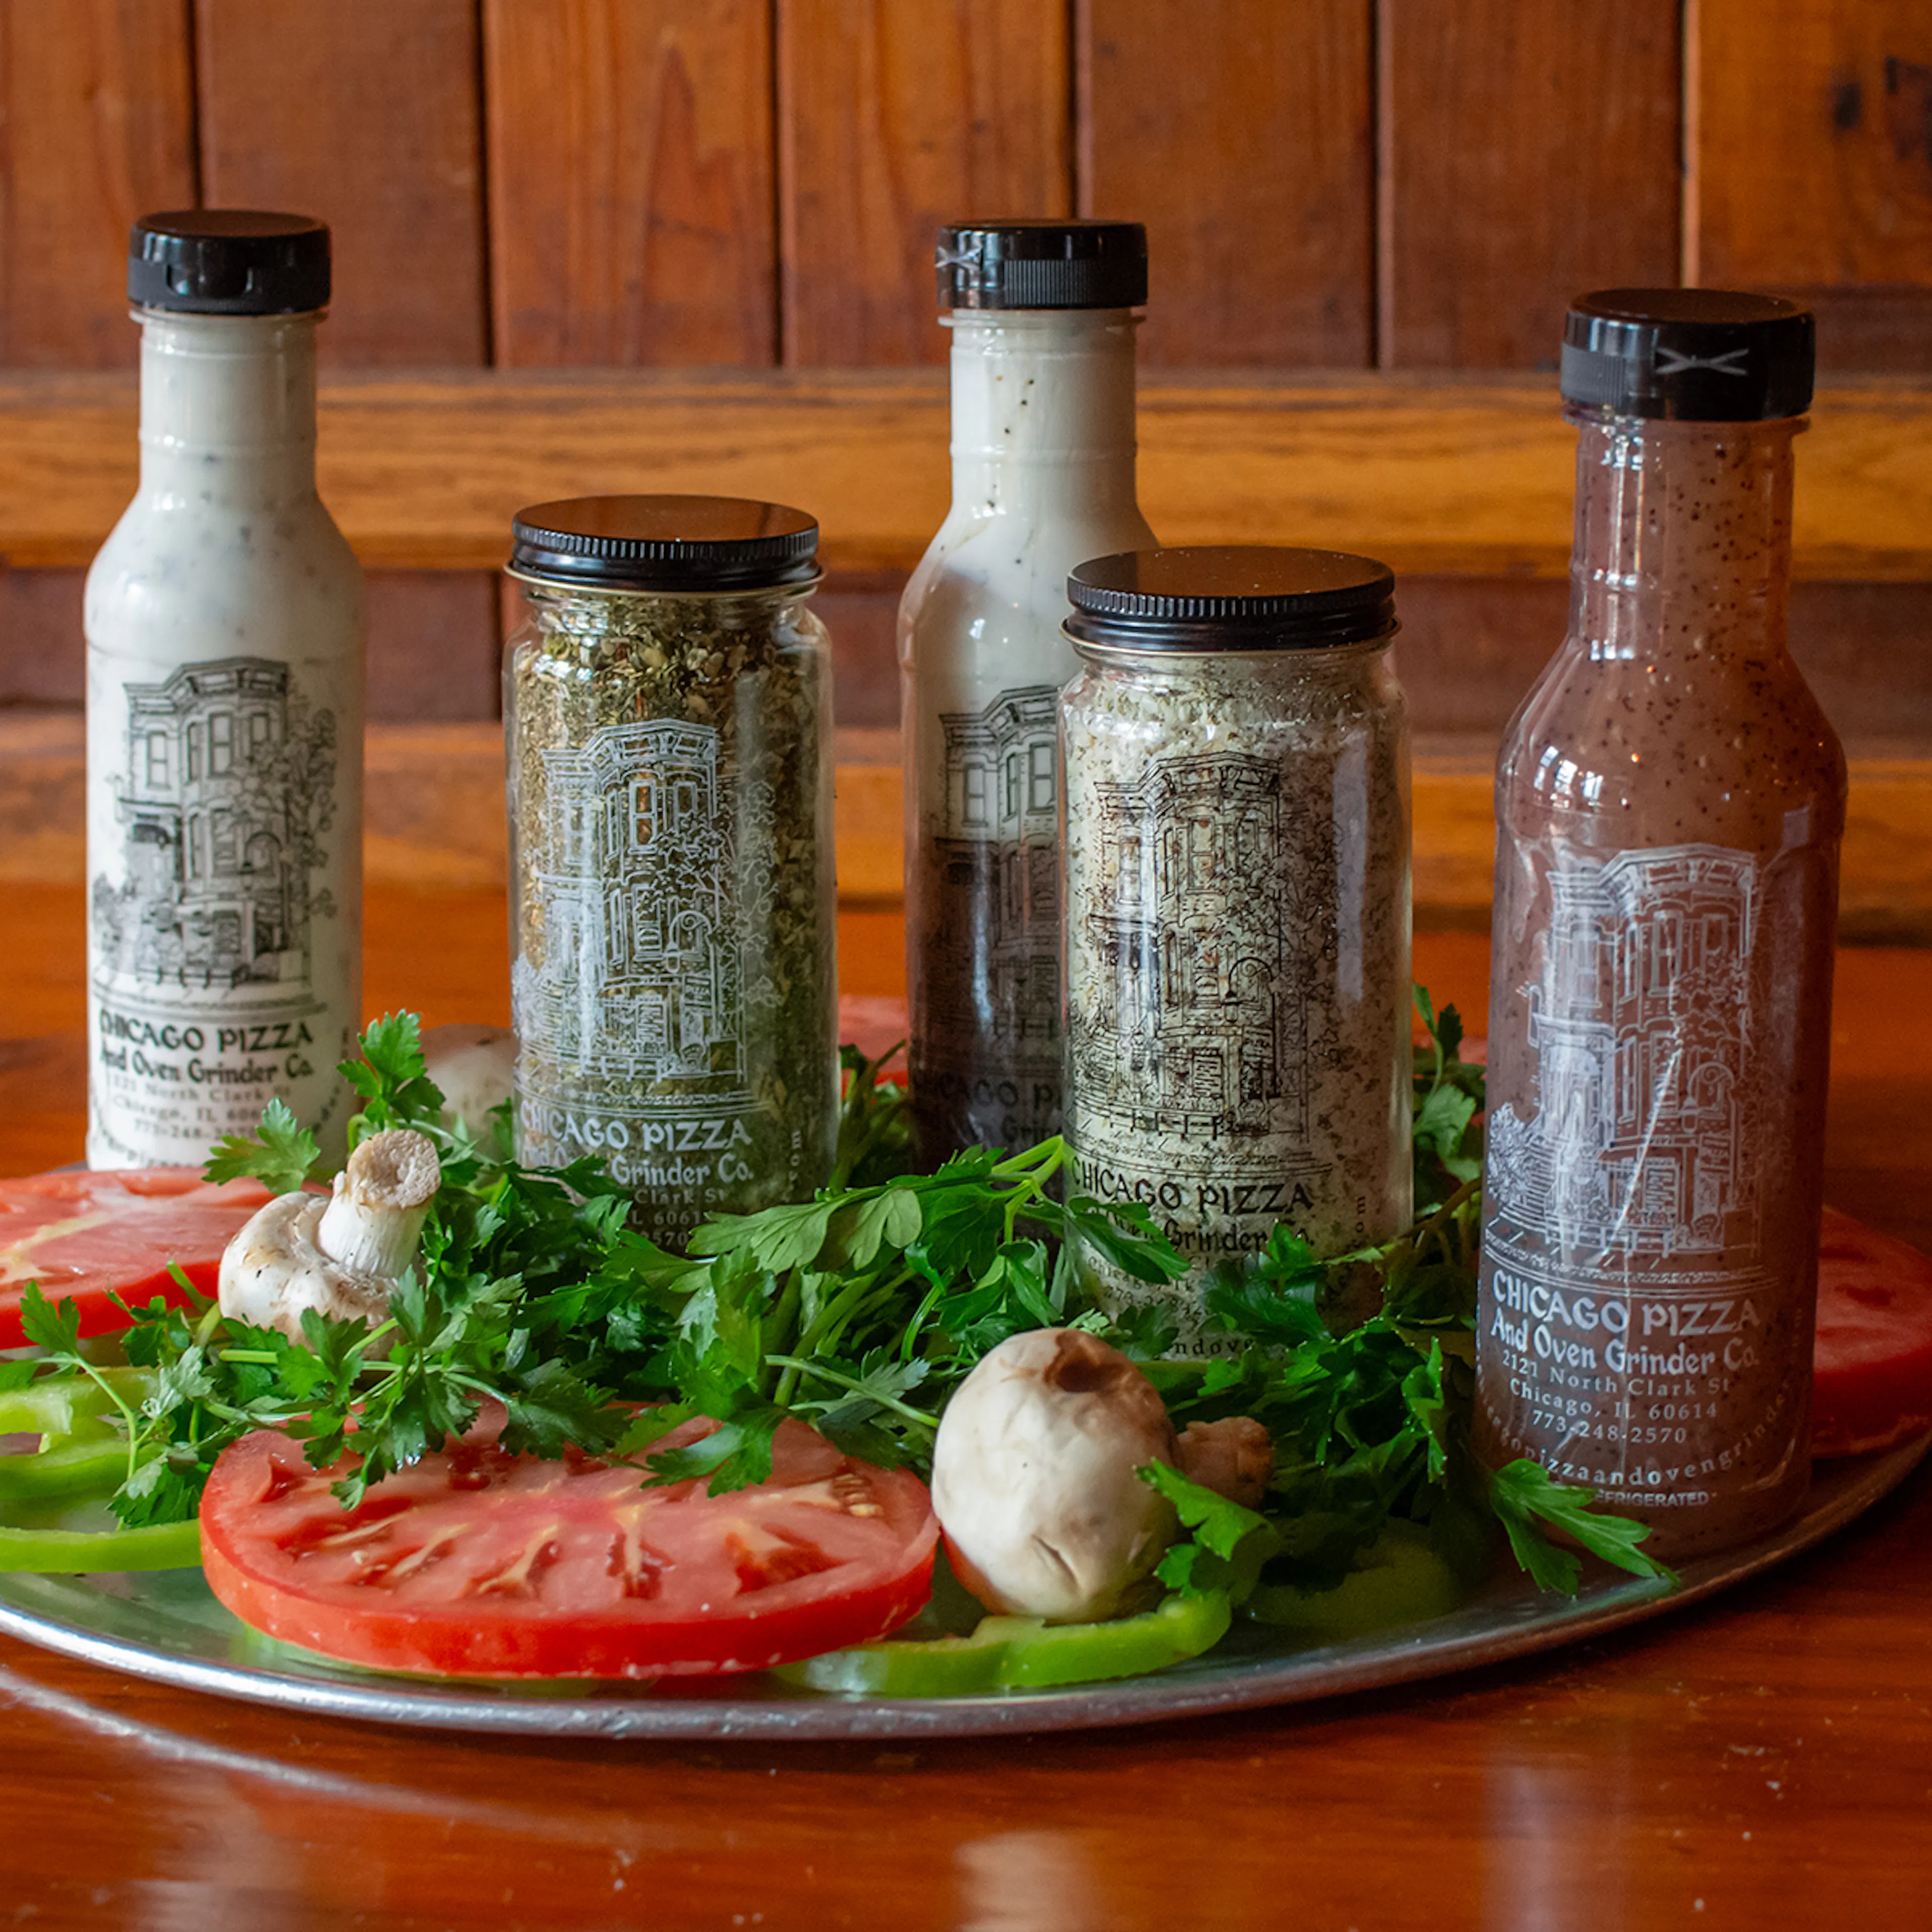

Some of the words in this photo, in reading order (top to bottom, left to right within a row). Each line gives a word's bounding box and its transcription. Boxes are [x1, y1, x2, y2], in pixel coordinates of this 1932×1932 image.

[218, 1021, 312, 1053] PIZZA
[132, 1050, 180, 1081] Oven
[187, 1058, 278, 1084] Grinder
[520, 1098, 629, 1150] CHICAGO
[641, 1118, 753, 1153] PIZZA
[611, 1153, 710, 1186] Grinder
[717, 1152, 754, 1183] Co.
[1072, 1156, 1182, 1209] CHICAGO
[1196, 1182, 1314, 1215] PIZZA
[634, 1188, 695, 1205] Clark
[654, 1210, 701, 1226] 6061
[1164, 1218, 1267, 1252] Grinder
[1493, 1269, 1628, 1333] CHICAGO
[1641, 1298, 1760, 1336] PIZZA
[1490, 1306, 1529, 1353] And
[1534, 1324, 1597, 1369] Oven
[1604, 1338, 1716, 1376] Grinder
[1502, 1349, 1538, 1378] 2121
[1549, 1366, 1618, 1394] North
[1627, 1377, 1697, 1397] Clark
[1708, 1377, 1729, 1394] St
[1510, 1377, 1601, 1417] Chicago,
[1648, 1403, 1718, 1425] 60614
[1594, 1488, 1709, 1507] EFRIGERATED
